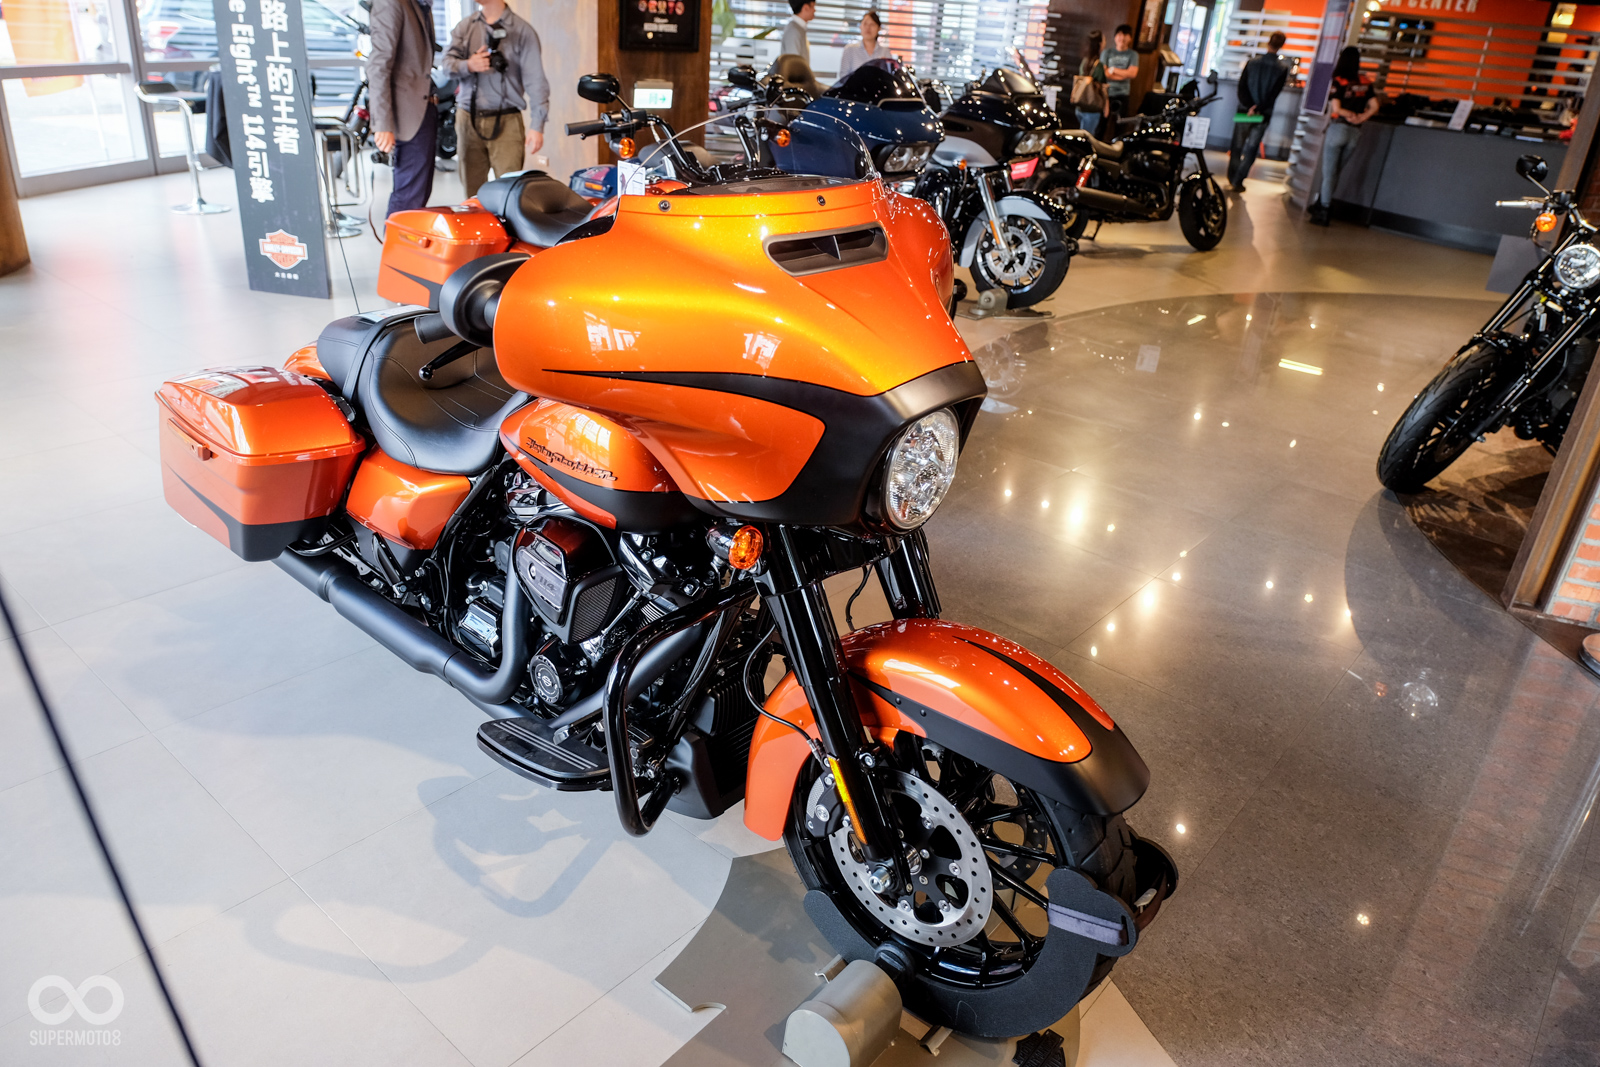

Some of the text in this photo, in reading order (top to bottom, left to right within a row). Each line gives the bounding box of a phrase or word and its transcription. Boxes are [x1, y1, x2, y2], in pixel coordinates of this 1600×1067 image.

[260, 0, 299, 155] 路上的王者
